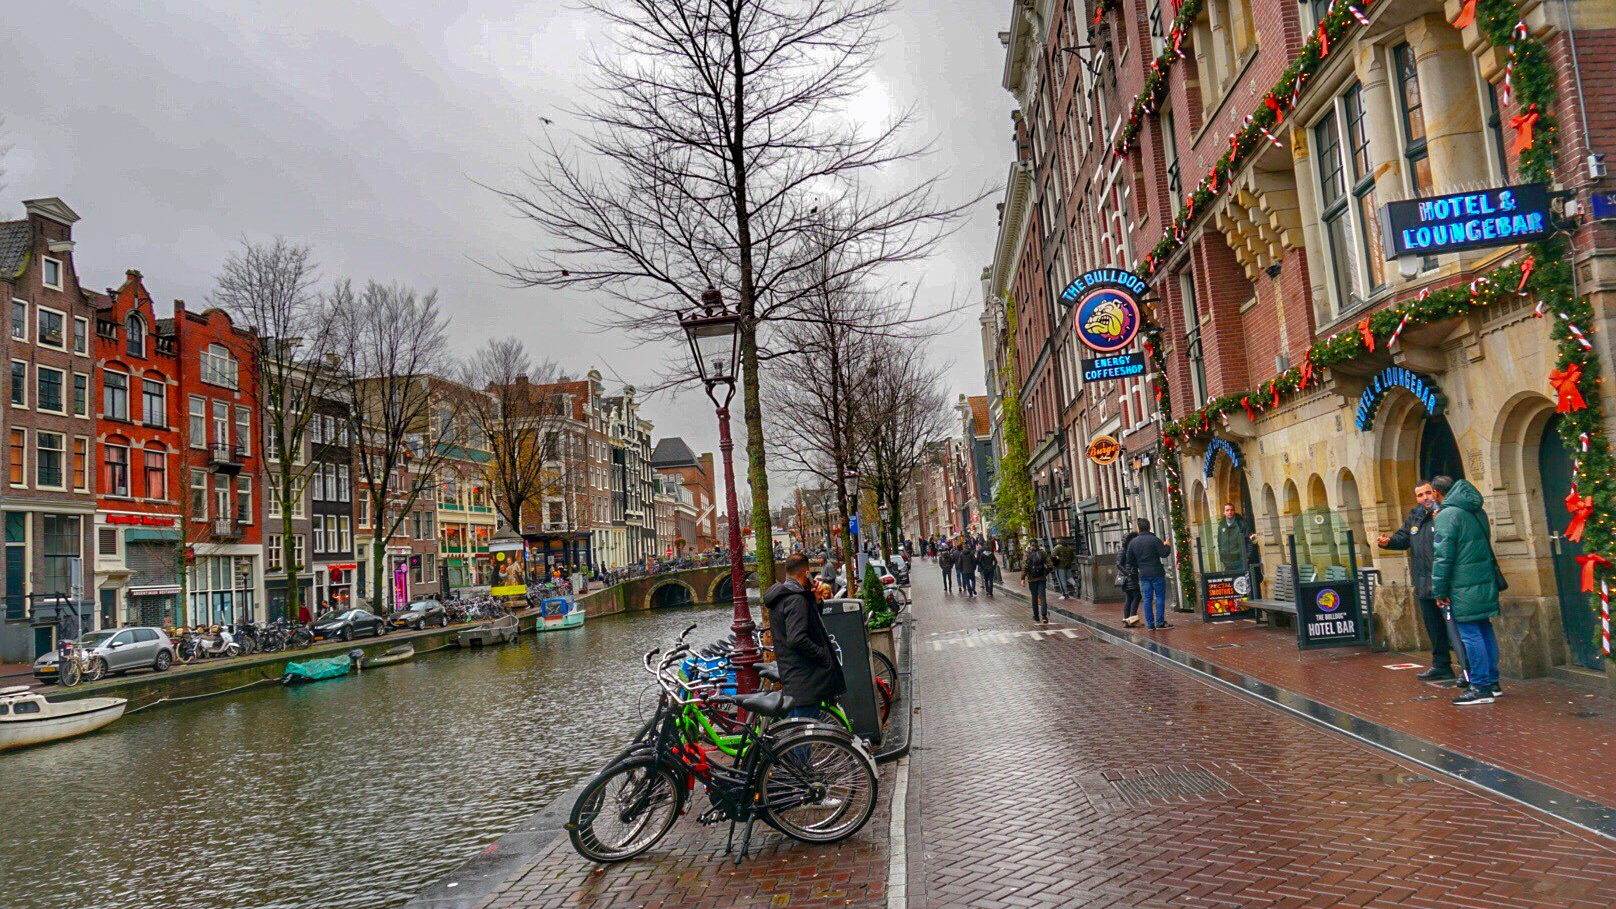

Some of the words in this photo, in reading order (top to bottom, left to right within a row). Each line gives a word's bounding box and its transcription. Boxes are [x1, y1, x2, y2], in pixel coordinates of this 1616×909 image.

[1418, 194, 1496, 222] HOTEL
[1497, 190, 1517, 212] &
[1403, 212, 1544, 249] LOUNGEBAR
[1062, 279, 1087, 301] THE
[1084, 270, 1146, 294] BULLDOG
[1085, 364, 1143, 380] COFFEESHOP
[1094, 355, 1131, 368] ENERGY
[1381, 367, 1436, 415] LOUNGEBAR
[1086, 443, 1121, 458] Burger
[1308, 622, 1335, 636] HOTEL
[1336, 621, 1355, 634] BAR
